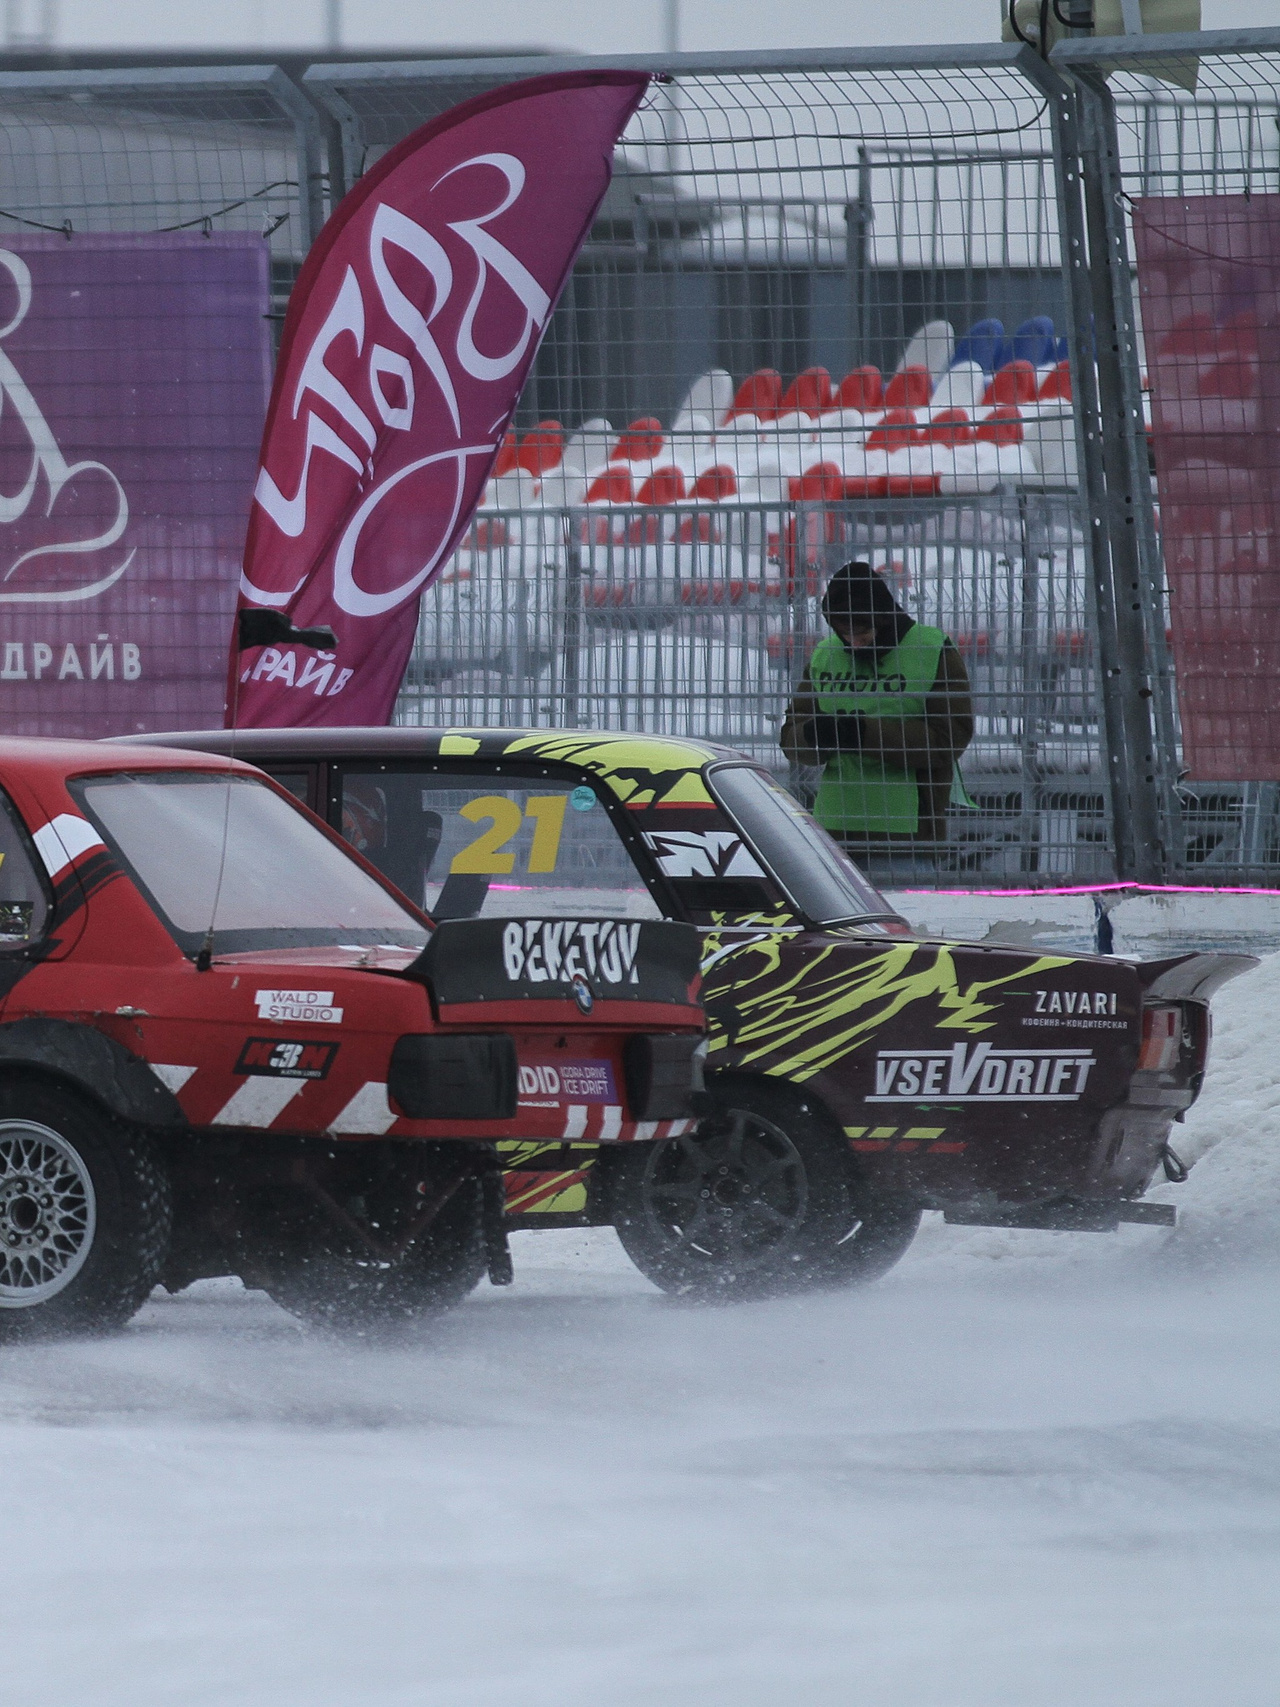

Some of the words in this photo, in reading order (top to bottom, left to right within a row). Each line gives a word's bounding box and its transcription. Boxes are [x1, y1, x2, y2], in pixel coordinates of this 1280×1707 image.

[0, 634, 142, 681] ДРАЙВ
[820, 672, 907, 692] PHOTO
[449, 795, 568, 874] 21
[503, 920, 642, 984] BEKETOV
[271, 992, 319, 1004] WALD
[1035, 990, 1118, 1015] ZAVARI
[268, 1005, 333, 1021] STUDIO
[584, 1067, 608, 1079] DRIVE
[874, 1042, 1097, 1096] VSEVDRIFT
[564, 1080, 580, 1094] ICE
[581, 1081, 609, 1095] DRIFT
